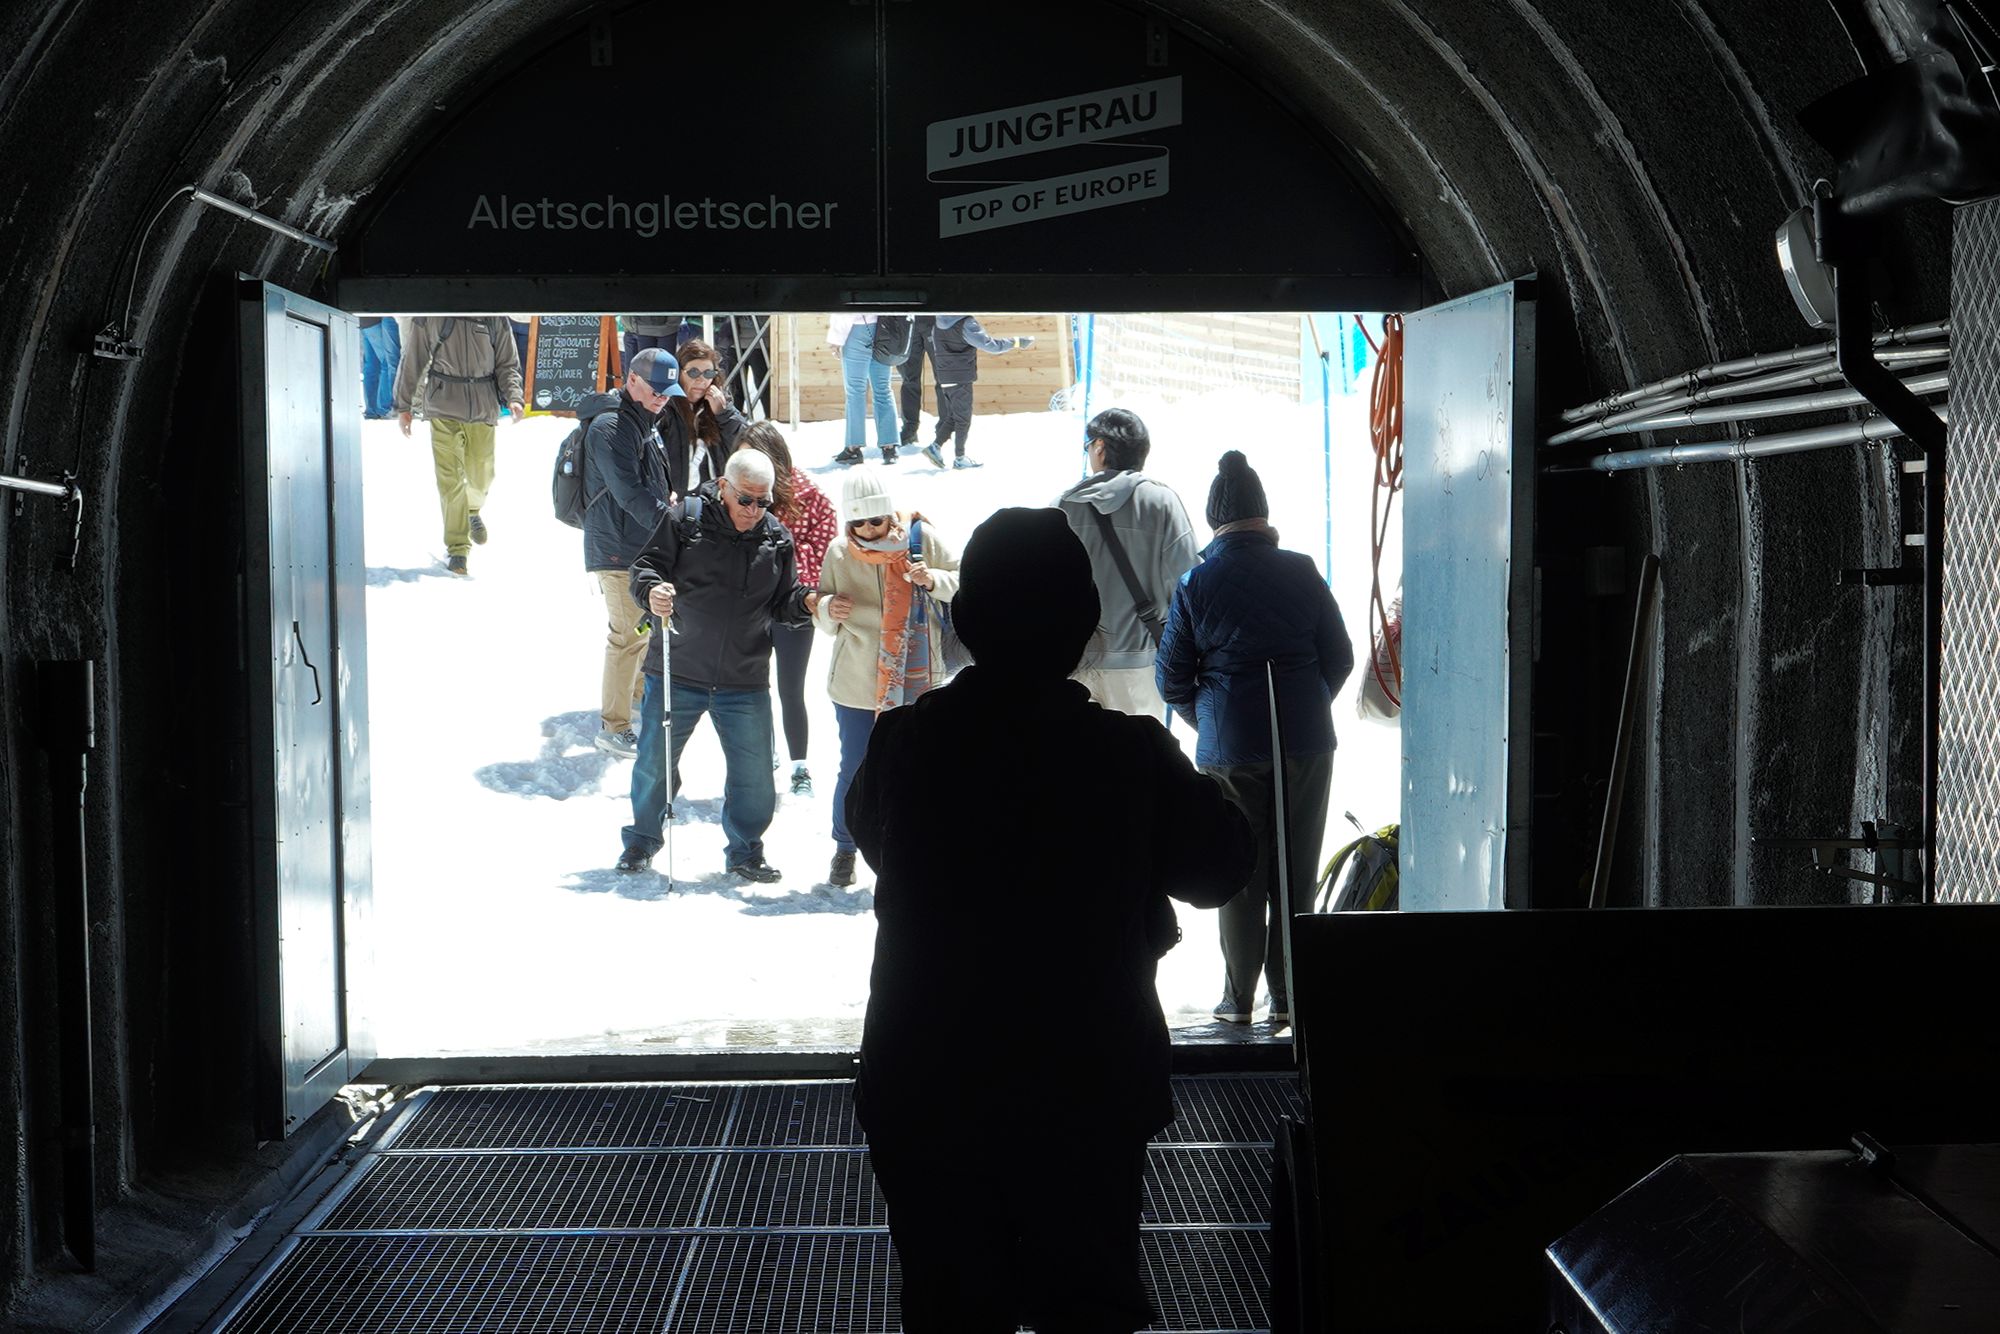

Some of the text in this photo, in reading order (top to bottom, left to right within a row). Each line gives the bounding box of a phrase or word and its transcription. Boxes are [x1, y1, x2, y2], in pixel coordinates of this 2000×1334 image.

[949, 90, 1159, 159] JUNGFRAU
[467, 194, 839, 239] Aletschgletscher
[952, 169, 1158, 225] TOP OF EUROPE
[537, 348, 552, 358] HOT
[553, 348, 578, 359] COFFEE
[537, 359, 563, 368] BEERS
